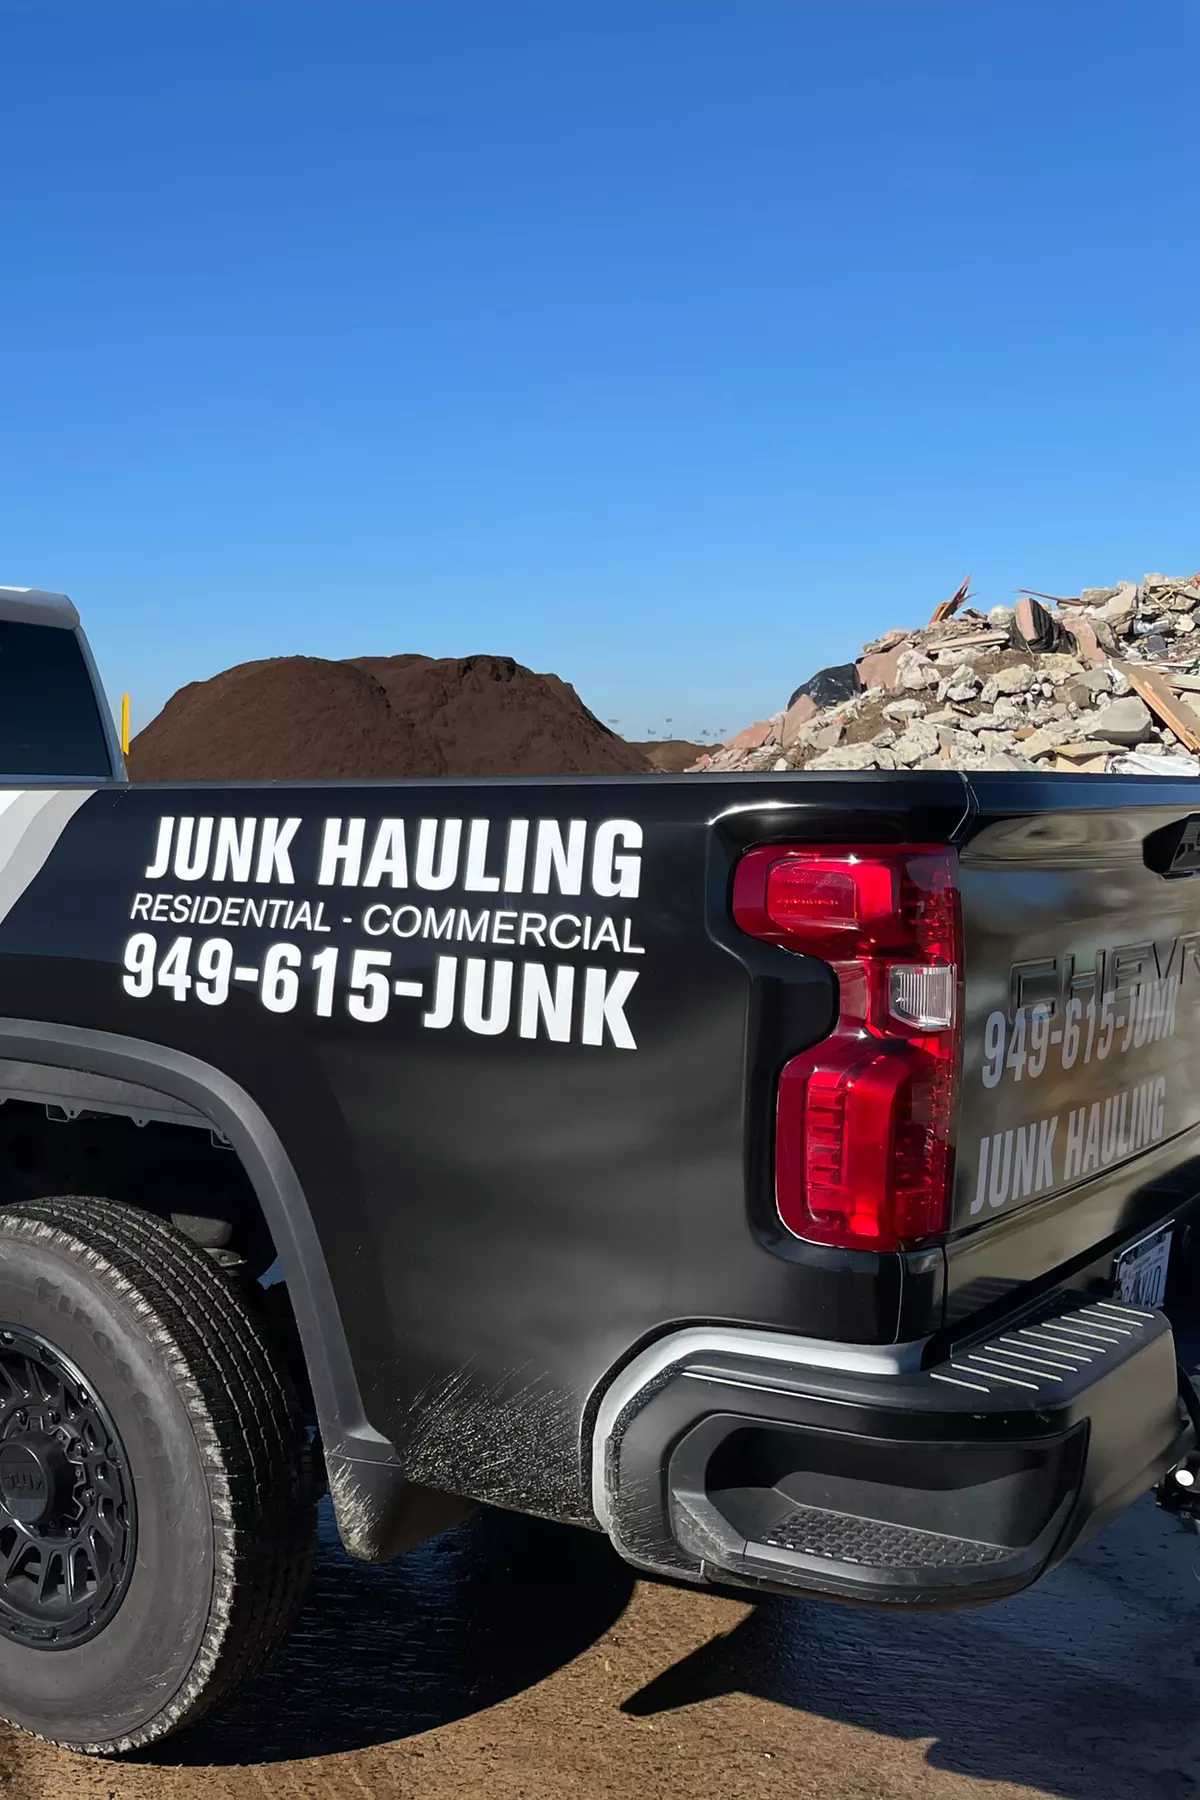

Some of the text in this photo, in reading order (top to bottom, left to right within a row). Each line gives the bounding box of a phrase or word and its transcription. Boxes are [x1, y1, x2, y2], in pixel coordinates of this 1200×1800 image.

[145, 816, 644, 899] JUNK HAULING
[130, 893, 331, 932] RESIDENTIAL
[363, 903, 646, 954] COMMERCIAL
[122, 932, 640, 1050] 949-615-JUNK
[982, 974, 1180, 1089] 949-615-JUNK
[970, 1076, 1166, 1215] JUNK HAULING
